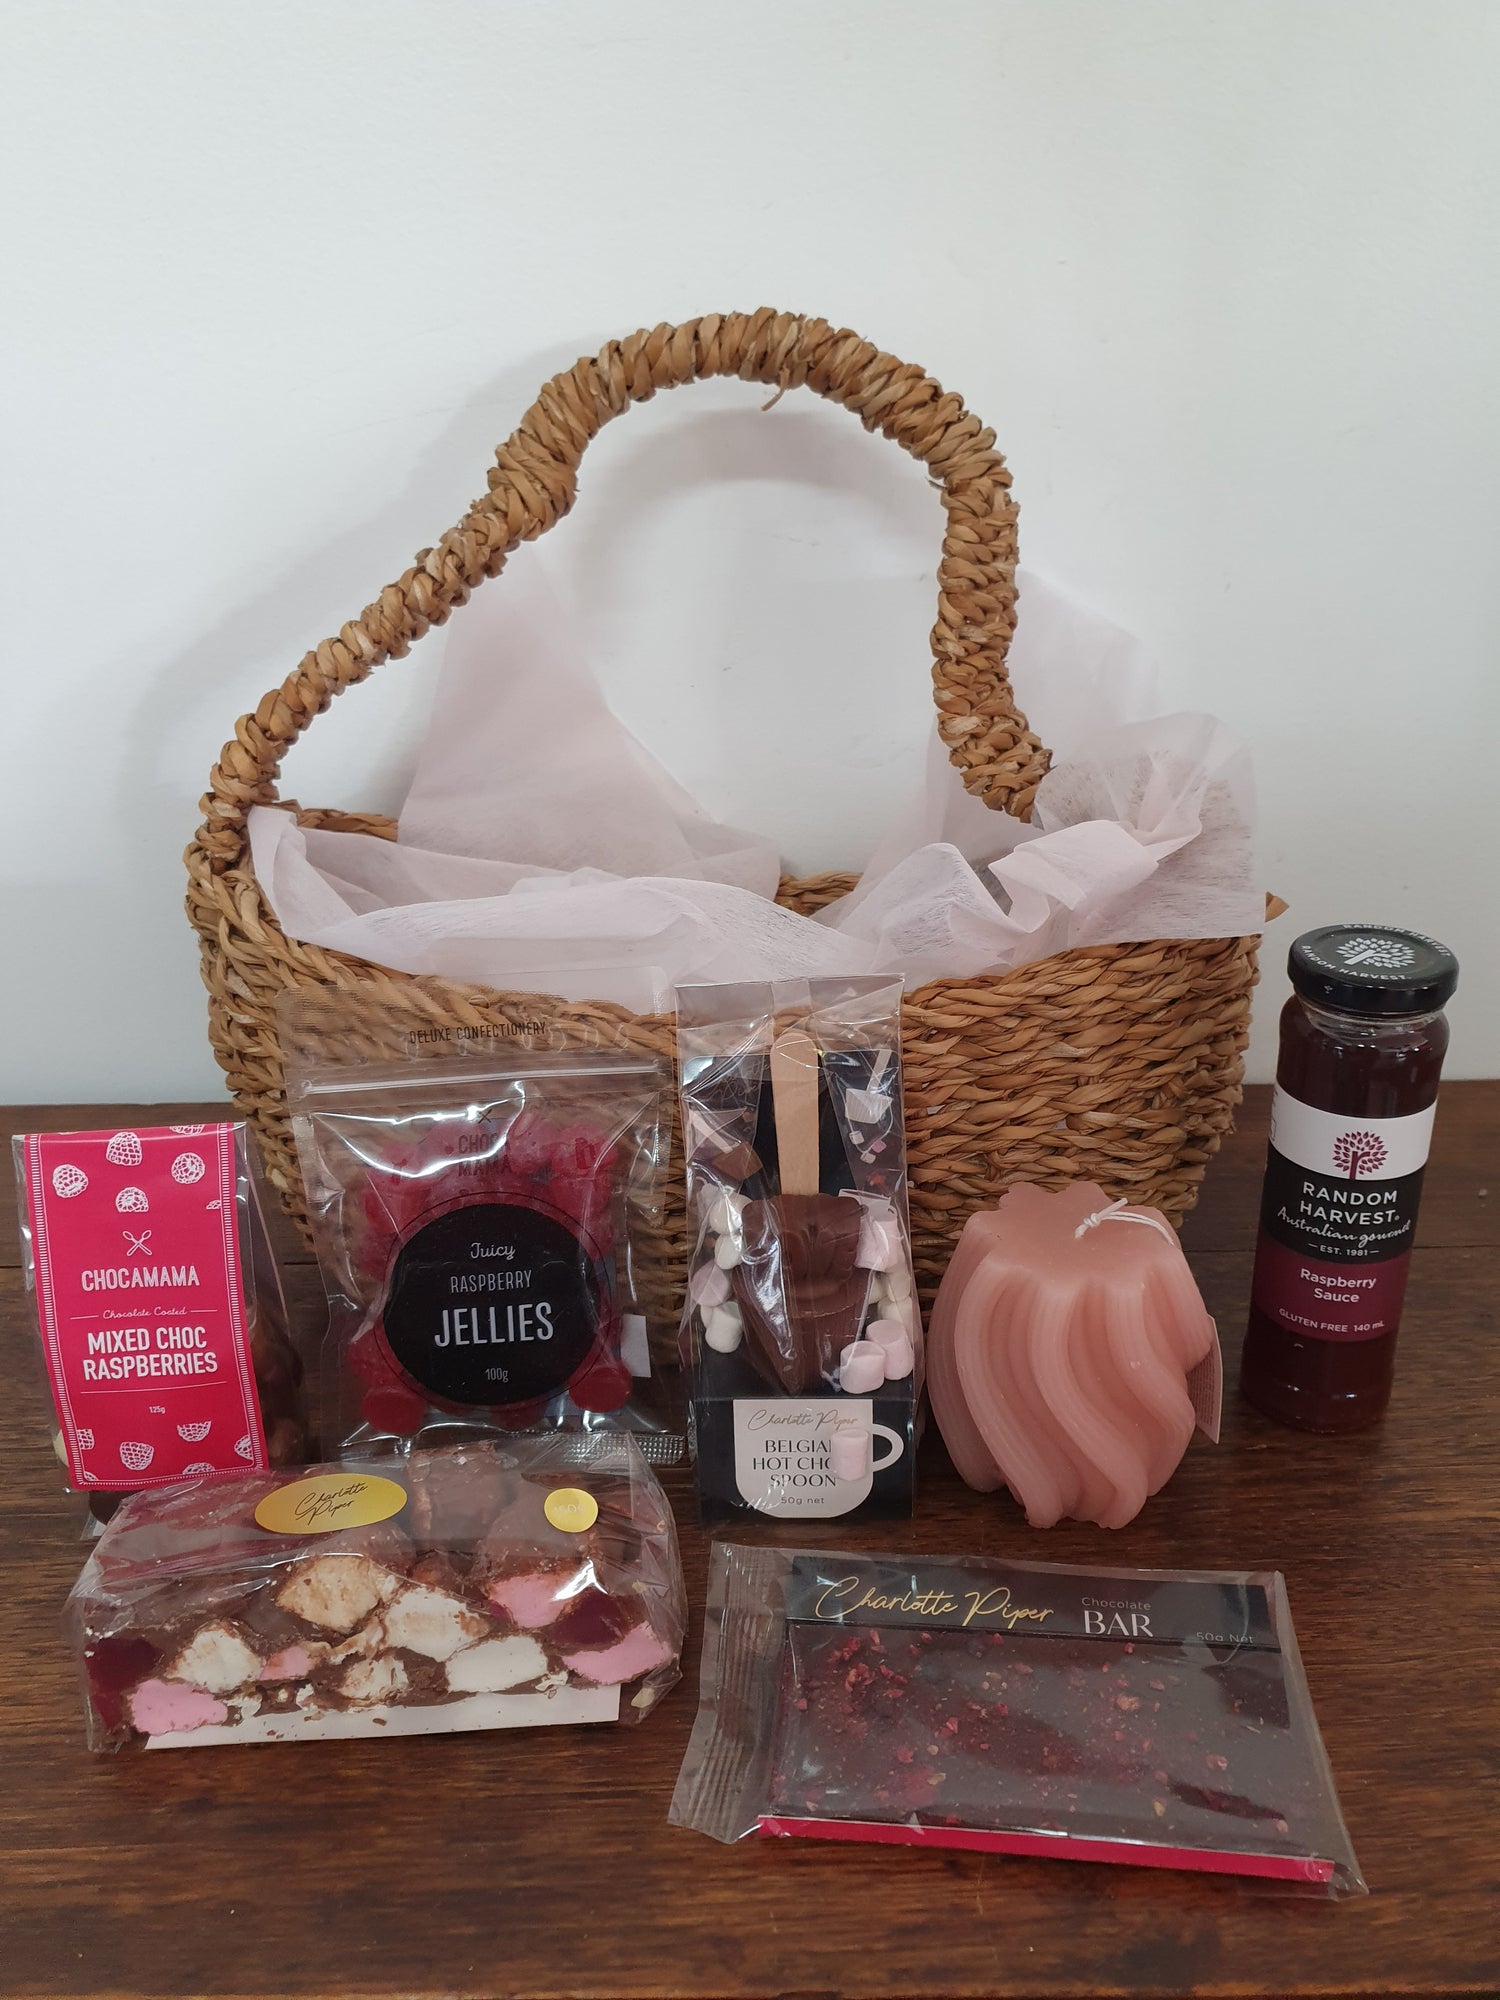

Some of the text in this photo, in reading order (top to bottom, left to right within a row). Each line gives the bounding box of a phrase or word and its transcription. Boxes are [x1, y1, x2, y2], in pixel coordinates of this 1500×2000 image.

[1301, 945, 1336, 970] RANDOM
[409, 1021, 546, 1044] DELUXE CONFECTIONERY
[1302, 1181, 1398, 1206] RANDOM
[1277, 1206, 1358, 1241] Australian
[470, 1242, 516, 1260] Juicy
[1320, 1244, 1342, 1255] EST.
[81, 1265, 200, 1292] CHOCAMAMA
[450, 1269, 532, 1293] RASPBERRY
[1300, 1268, 1377, 1289] Raspberry
[1313, 1288, 1360, 1303] Sauce
[102, 1306, 188, 1320] Chocolate Coated
[434, 1301, 554, 1347] JELLIES
[1279, 1308, 1318, 1329] GLUTEN
[1320, 1322, 1348, 1333] FREE
[1353, 1323, 1370, 1332] 140
[87, 1326, 207, 1355] MIXED CHOC
[82, 1351, 218, 1381] RASPBERRIES
[485, 1367, 509, 1383] 100g
[149, 1405, 166, 1414] 125g
[747, 1409, 858, 1431] Charlotte Piper
[753, 1457, 792, 1470] HOT
[770, 1473, 836, 1487] SPOON
[294, 1481, 369, 1515] Charlotte
[781, 1496, 803, 1505] 50g
[815, 1576, 1055, 1630] Charlotte Piper
[1081, 1596, 1152, 1611] Chocolate
[1084, 1609, 1154, 1637] BAR
[1229, 1634, 1254, 1644] Net
